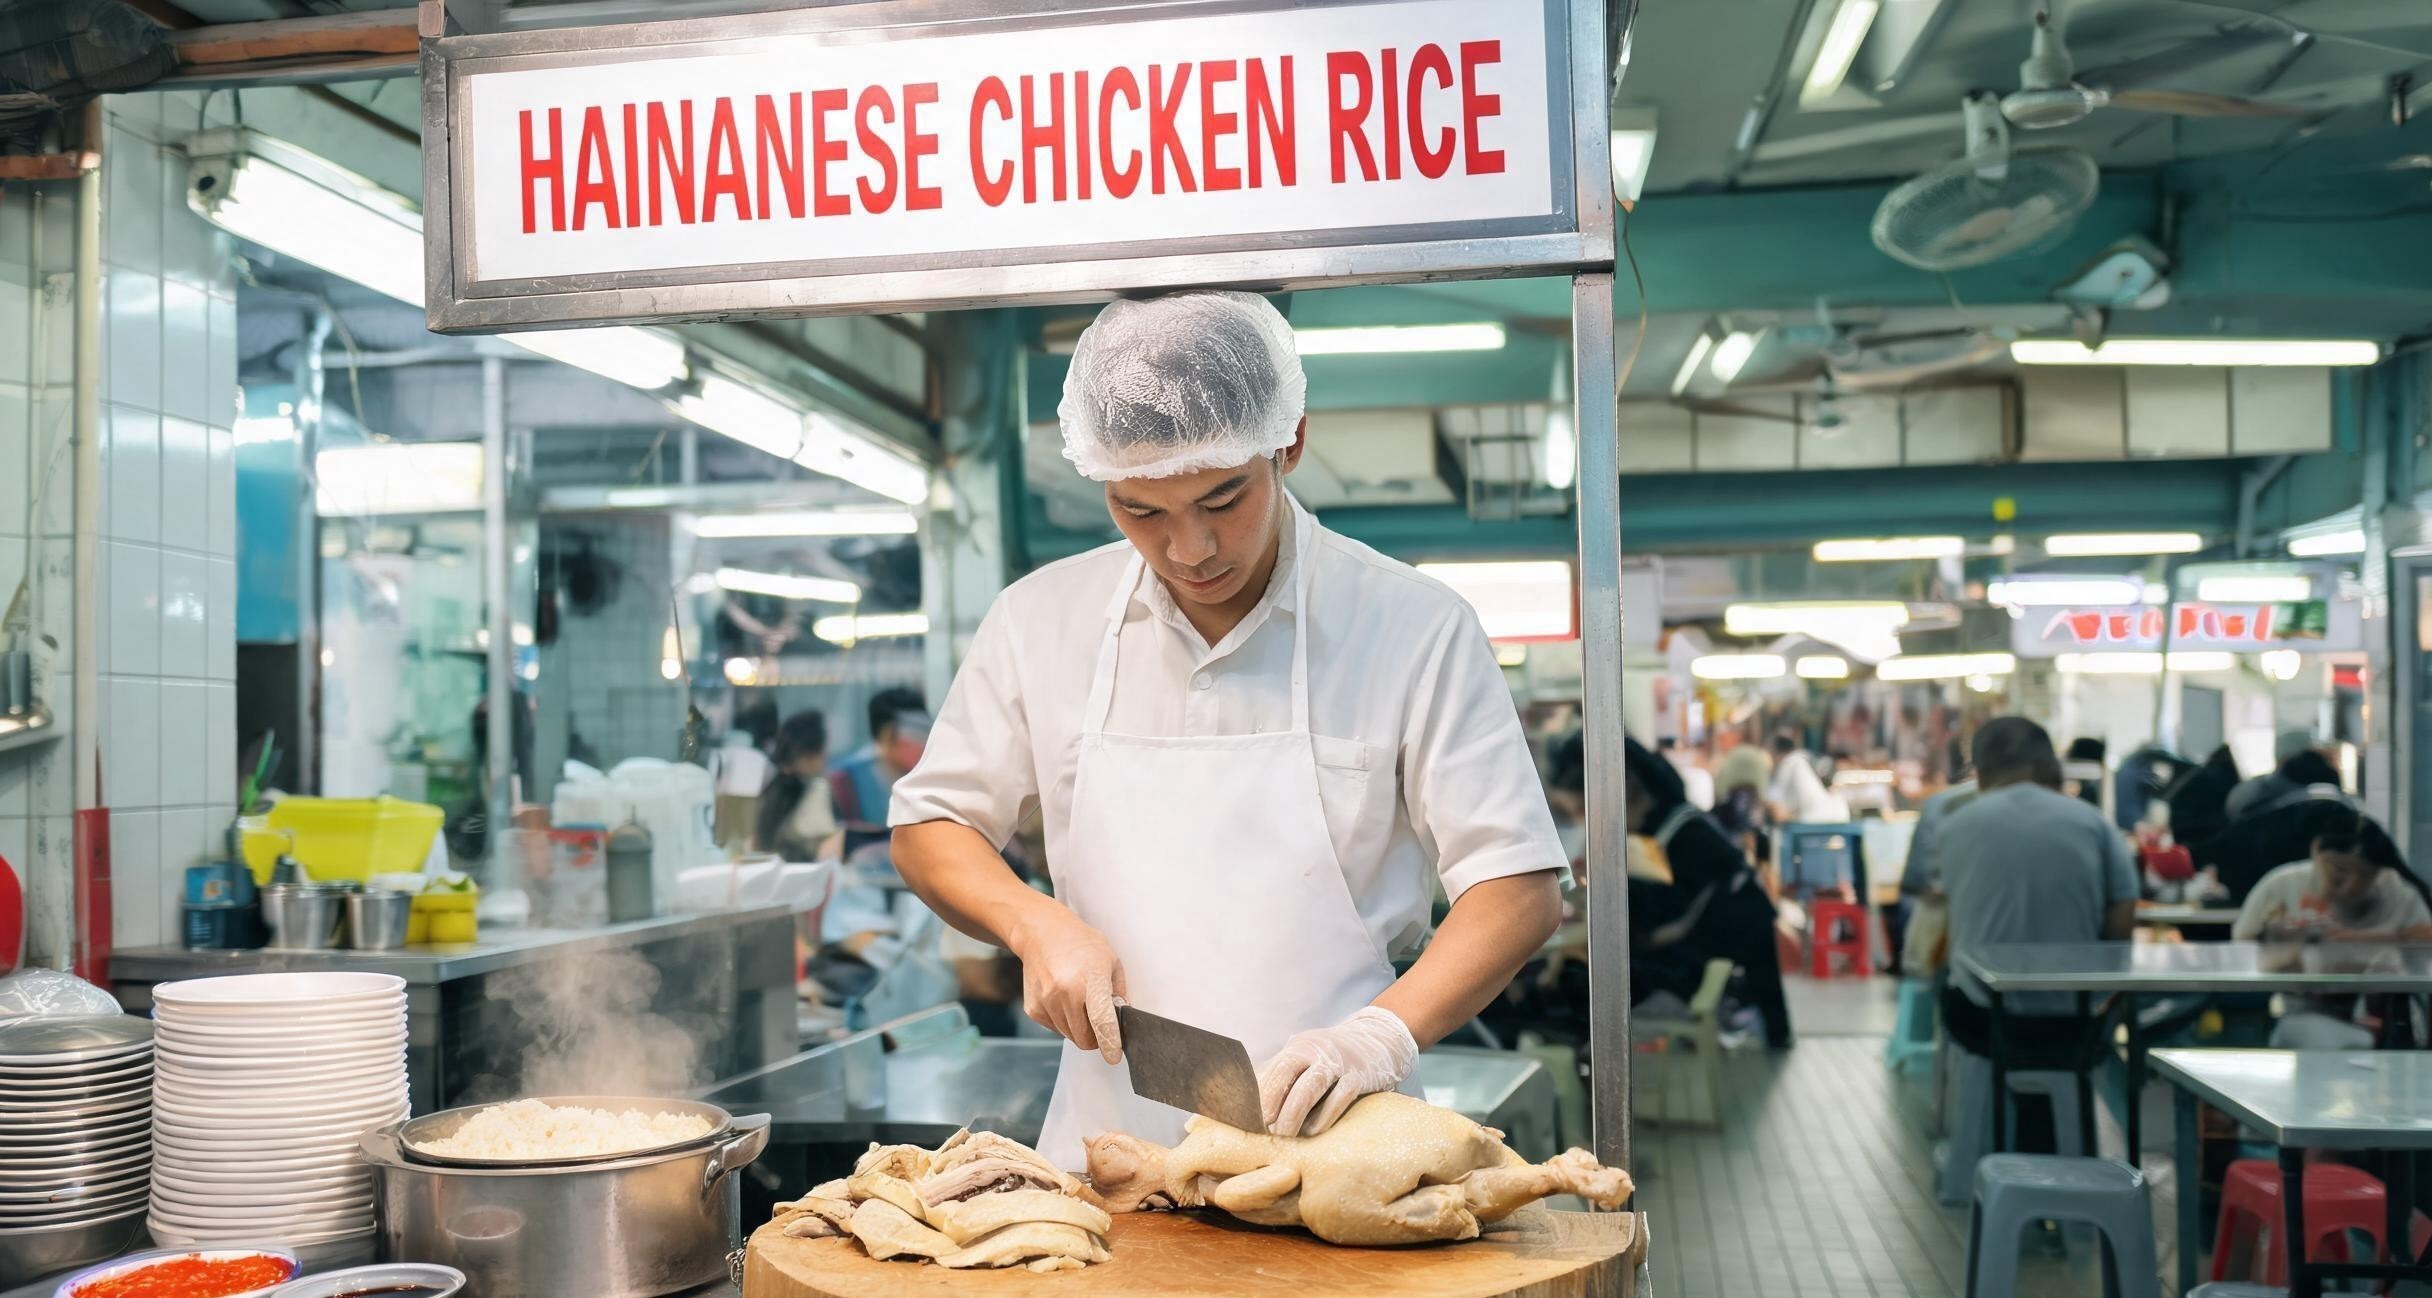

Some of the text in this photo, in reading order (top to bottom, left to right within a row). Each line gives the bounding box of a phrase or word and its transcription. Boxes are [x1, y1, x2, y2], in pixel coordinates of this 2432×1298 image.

[519, 39, 1506, 234] HAINANESE CHICKEN RICE
